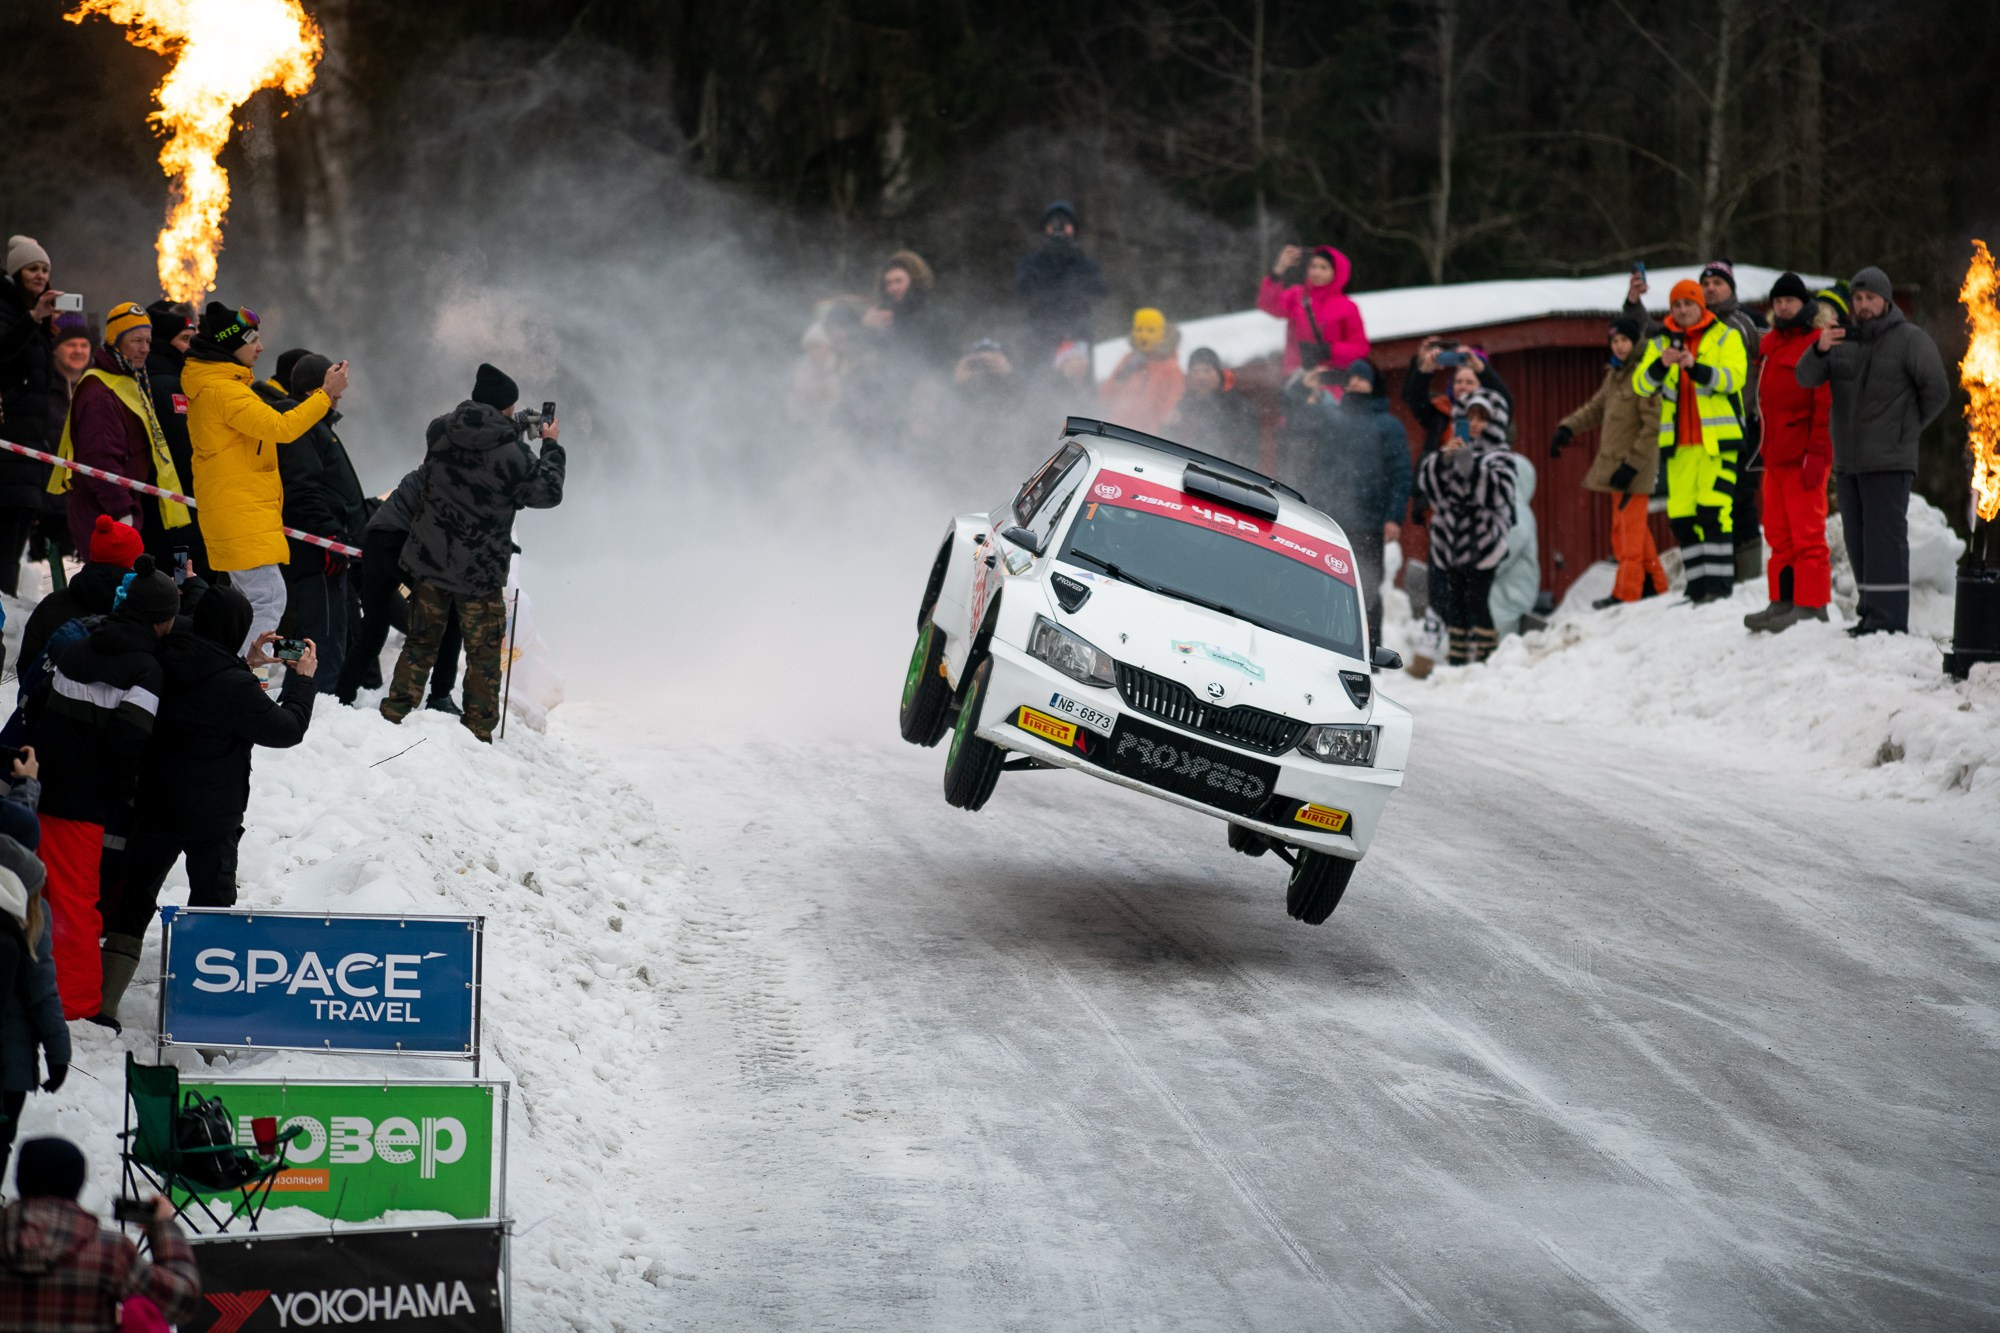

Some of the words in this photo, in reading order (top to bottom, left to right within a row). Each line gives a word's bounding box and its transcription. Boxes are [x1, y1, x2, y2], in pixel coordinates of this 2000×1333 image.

[1085, 502, 1099, 520] 1
[1056, 576, 1084, 592] PROSPEED
[1022, 711, 1071, 740] PIRELLI
[1117, 732, 1266, 799] PROSPEED
[1300, 807, 1343, 828] PIRELLI
[192, 948, 422, 999] SPACE
[310, 999, 421, 1023] TRAVEL
[270, 1280, 476, 1328] YOKOHAMA
